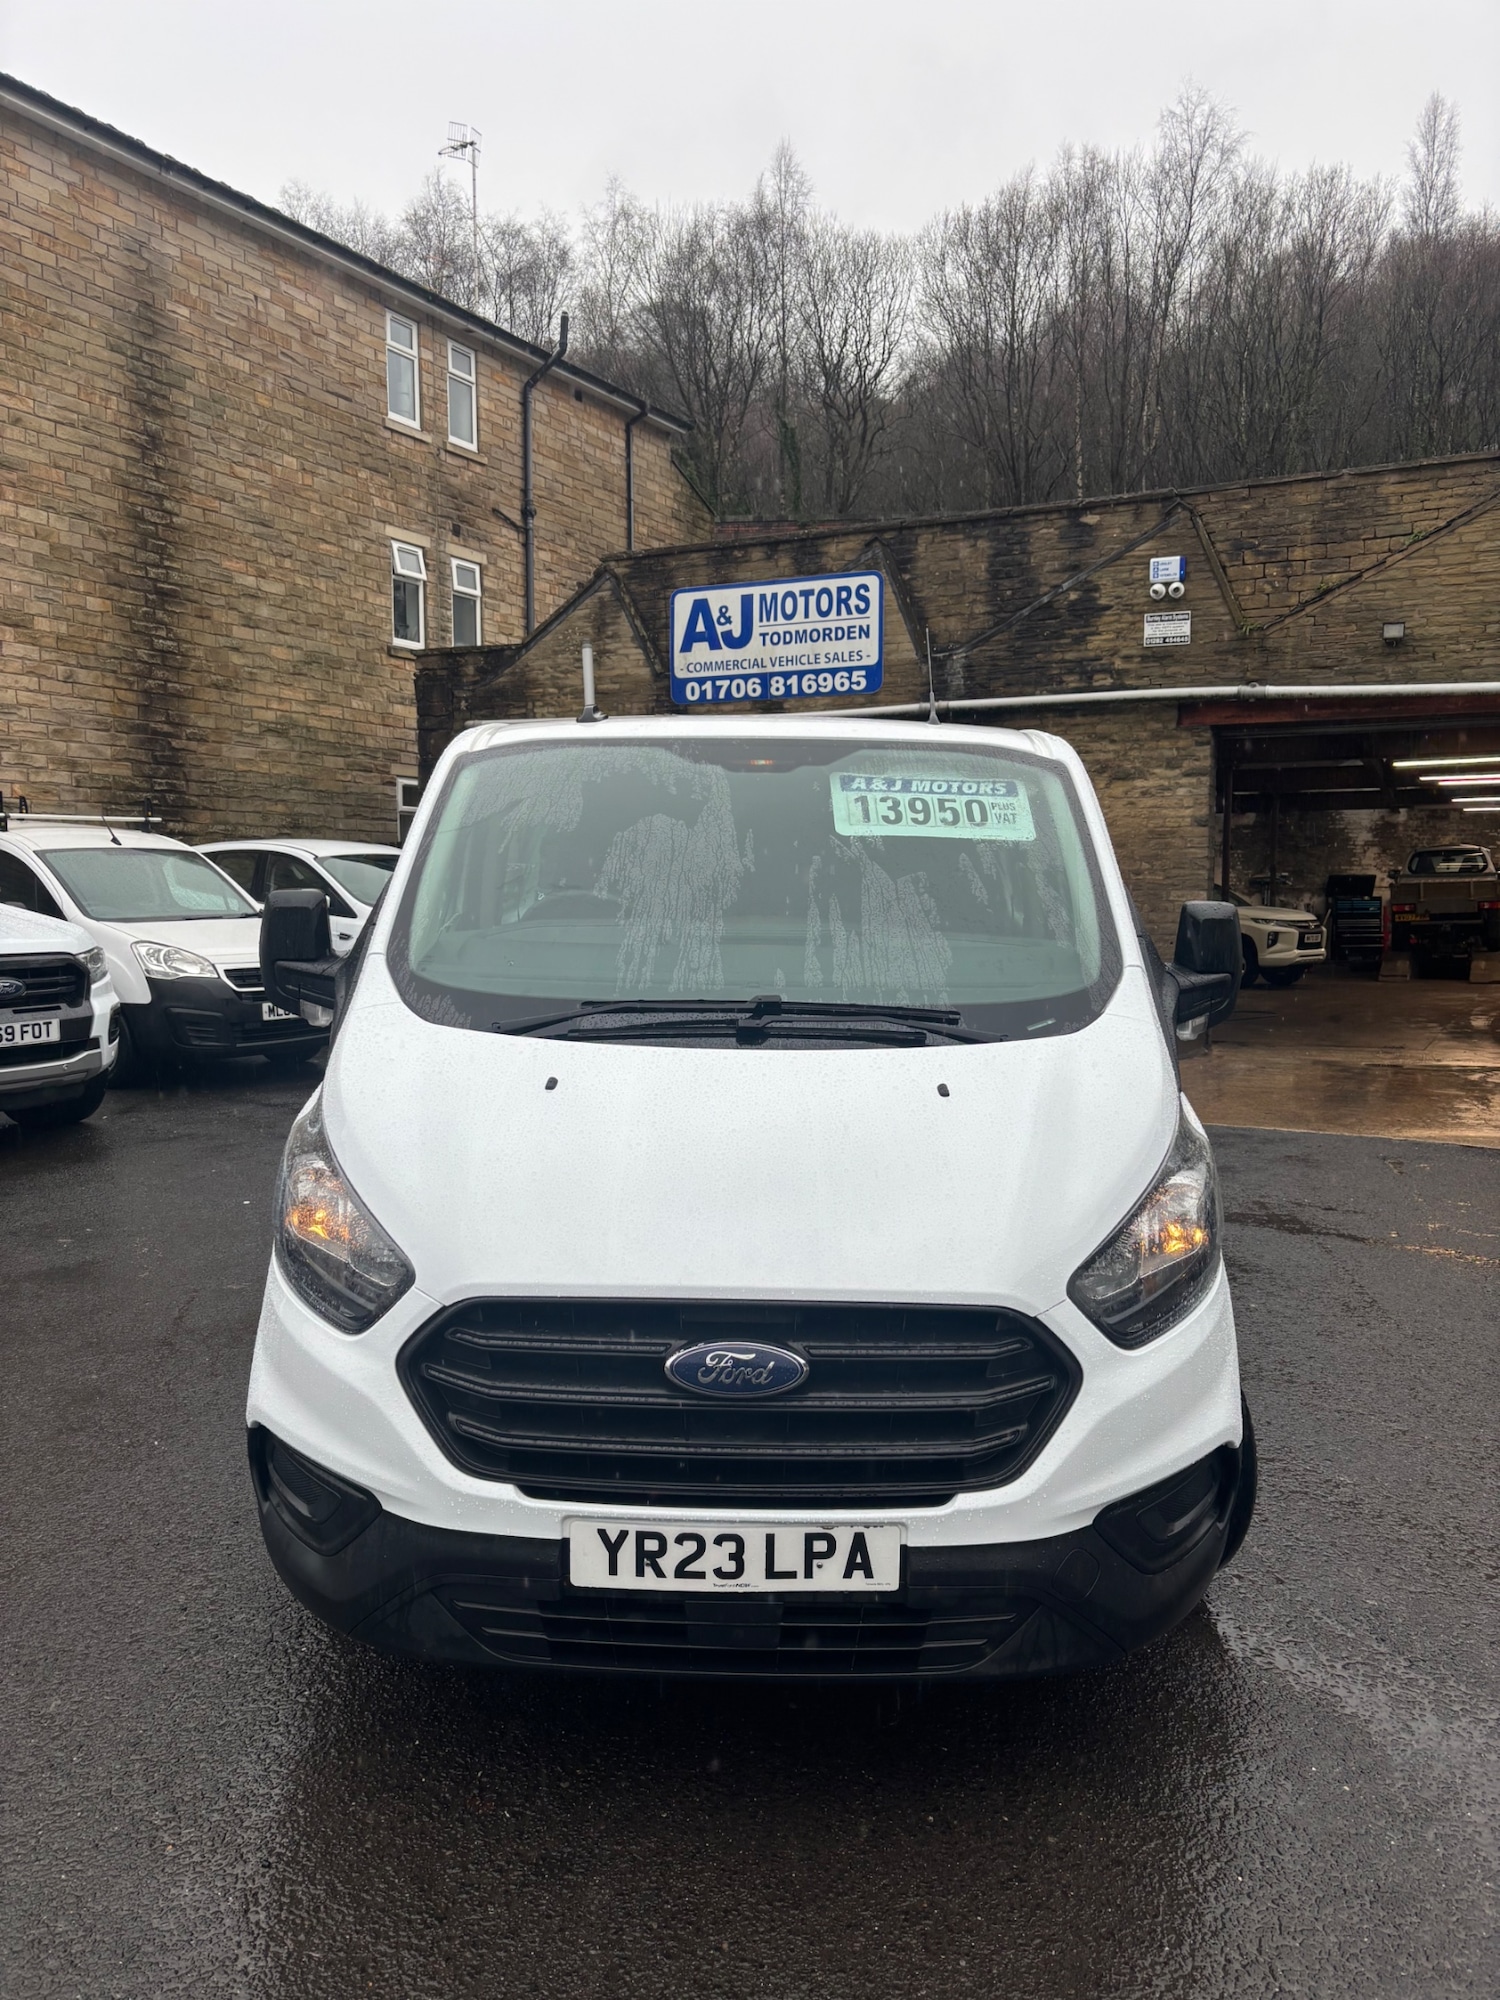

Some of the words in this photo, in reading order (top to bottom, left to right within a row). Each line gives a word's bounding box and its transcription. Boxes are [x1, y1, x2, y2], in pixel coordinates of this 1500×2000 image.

[679, 593, 754, 654] A&J
[759, 583, 870, 623] MOTORS
[759, 624, 870, 647] TODMORDEN
[686, 657, 767, 674] COMMERCIAL
[769, 653, 821, 668] VEHICLE
[824, 650, 863, 664] SALES
[685, 677, 762, 701] 01706
[769, 670, 867, 697] 816965
[851, 777, 904, 792] A&J
[911, 779, 1008, 795] MOTORS
[853, 795, 990, 828] 13950
[991, 801, 1016, 811] PLUS
[994, 812, 1017, 825] VAT
[0, 1025, 15, 1043] 9
[697, 1350, 776, 1385] Ford
[596, 1527, 746, 1580] YR23
[764, 1531, 875, 1580] LPA
